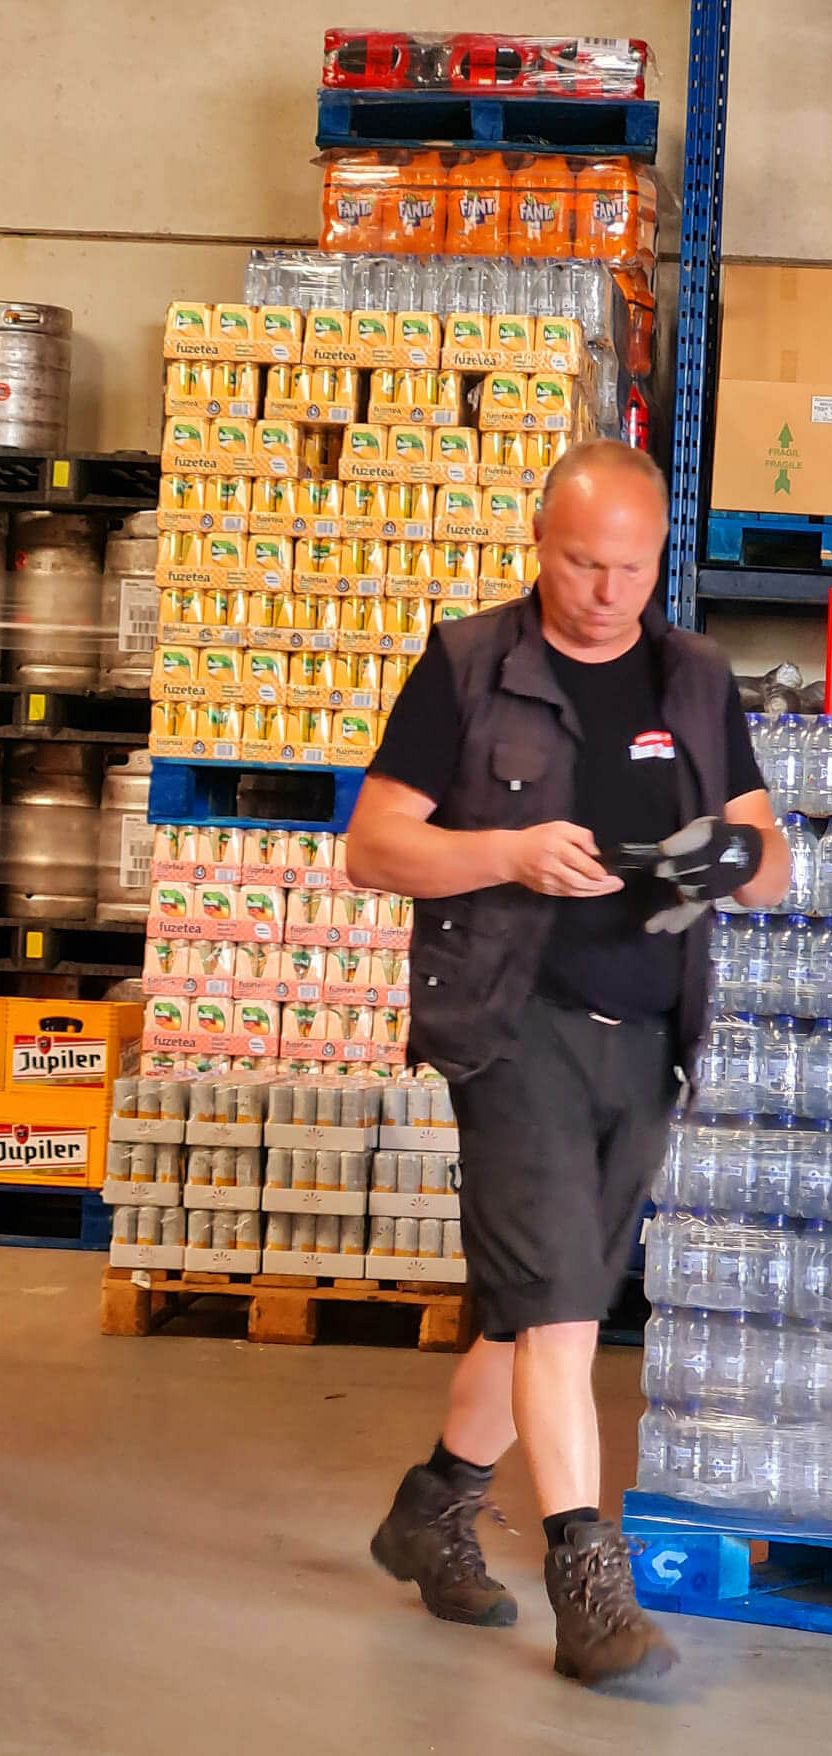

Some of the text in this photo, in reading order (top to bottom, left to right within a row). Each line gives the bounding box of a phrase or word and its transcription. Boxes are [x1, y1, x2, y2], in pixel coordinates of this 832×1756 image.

[336, 199, 372, 218] FANTA
[398, 199, 434, 218] FANTA
[519, 202, 555, 221] FANTA
[176, 342, 219, 355] fuzetea
[313, 348, 357, 361] fuzetea
[454, 353, 497, 366] fuzetea
[768, 448, 800, 458] FRAGIL
[175, 456, 217, 469] fuzetea
[351, 465, 394, 478] fuzetea
[446, 523, 489, 537] fuzetea
[168, 571, 210, 583] fuzetea
[163, 683, 206, 696] fuzetea
[159, 922, 202, 935] fuzetea
[154, 1035, 197, 1048] fuzetea
[18, 1049, 101, 1074] Jupiler
[0, 1139, 80, 1164] Jupiler
